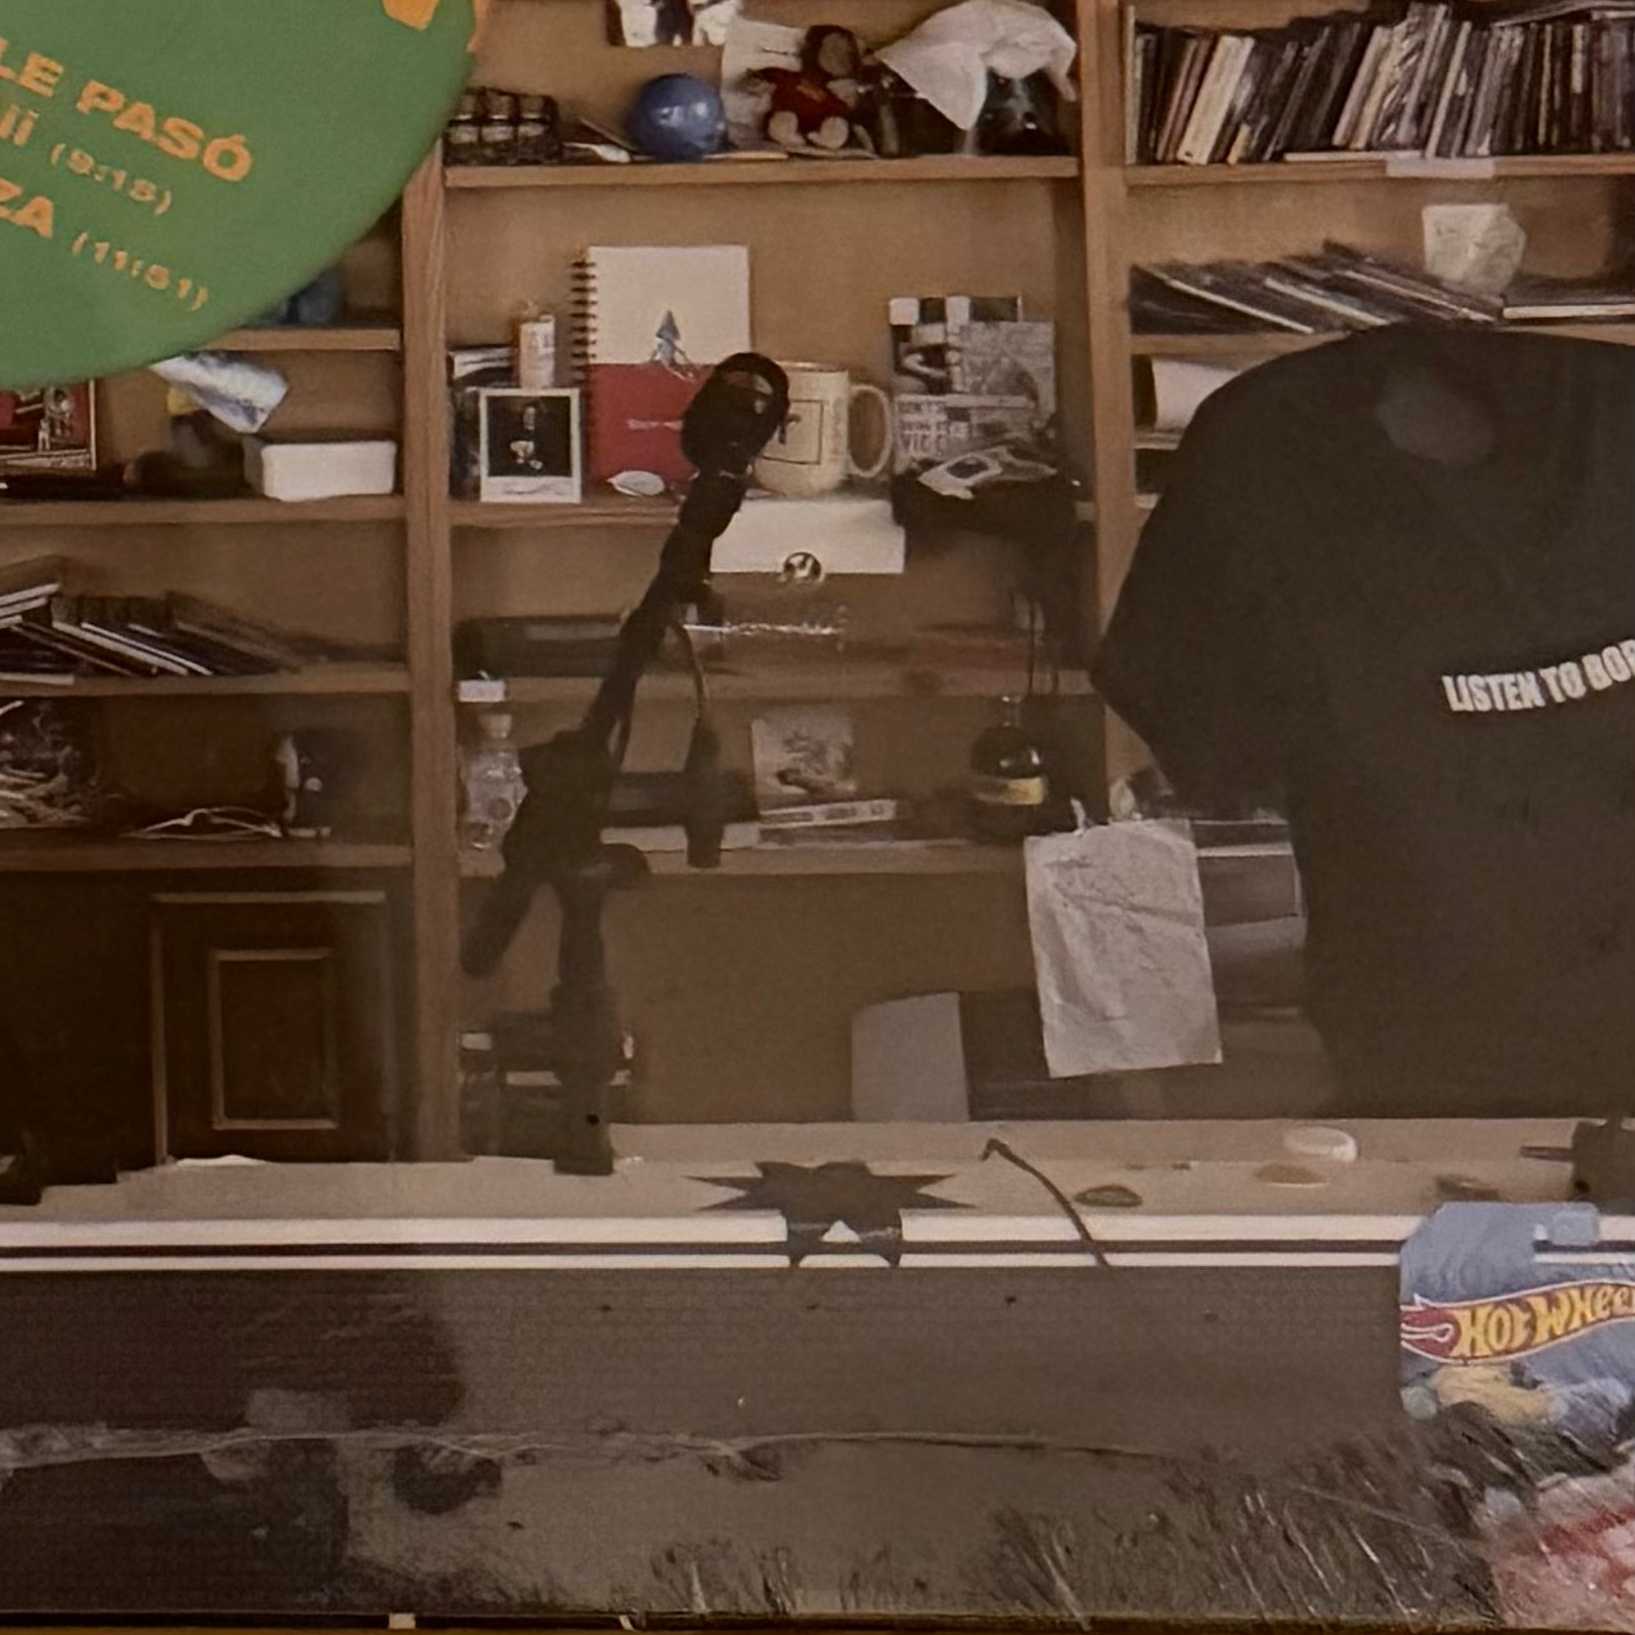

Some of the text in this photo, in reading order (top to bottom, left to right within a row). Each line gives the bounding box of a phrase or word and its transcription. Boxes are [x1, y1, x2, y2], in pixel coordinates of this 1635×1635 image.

[76, 79, 253, 183] PASÓ
[1441, 671, 1547, 712] LISTEN
[1538, 661, 1588, 704] TO
[1449, 1302, 1533, 1358] HOT
